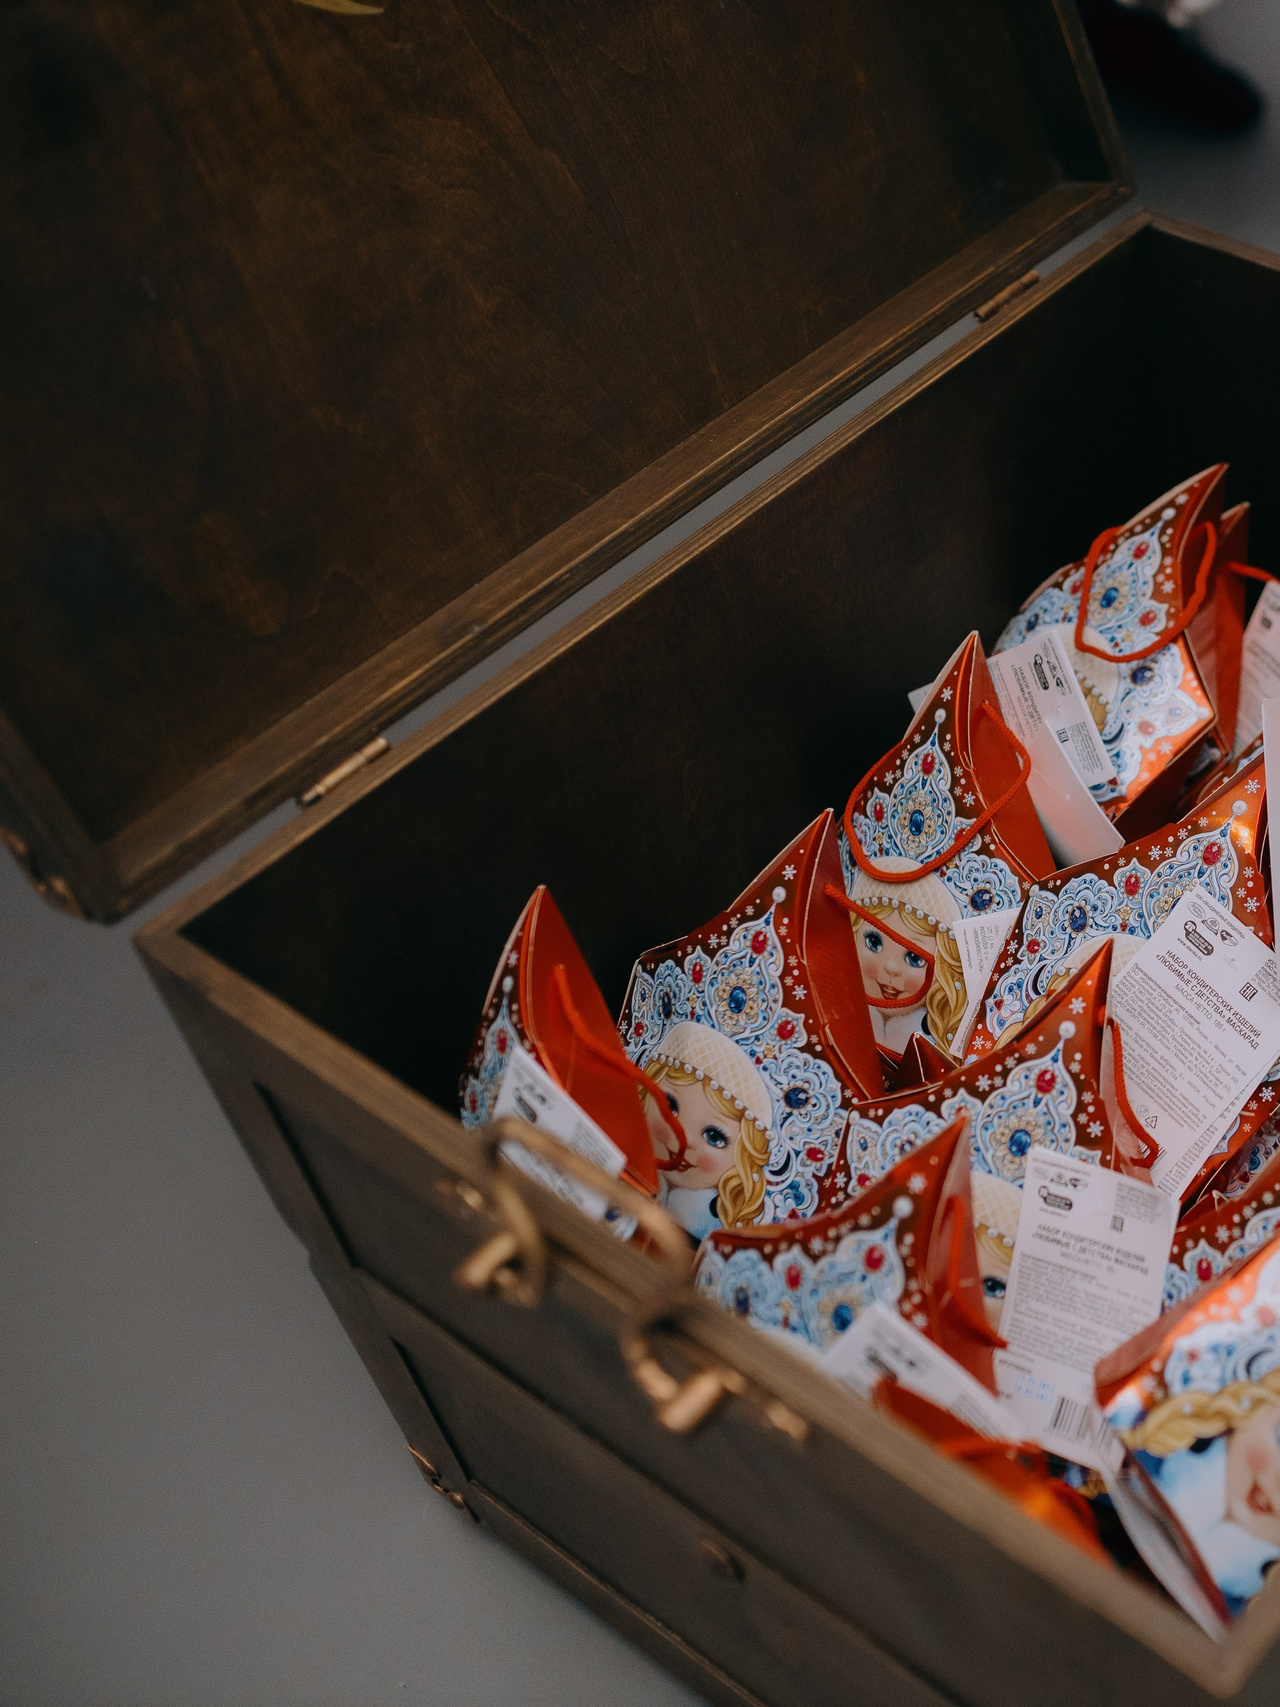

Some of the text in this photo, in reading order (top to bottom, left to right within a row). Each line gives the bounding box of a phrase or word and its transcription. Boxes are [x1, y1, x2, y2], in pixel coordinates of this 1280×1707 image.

[1154, 951, 1260, 1050] «ЛЮБИМЫЕ С ДЕТСТВА» МАСКАРАД
[1164, 949, 1262, 1039] НАБОР КОНДИТЕРСКИХ ИЗДЕЛИЙ
[1173, 983, 1195, 1004] МАССА
[1191, 1000, 1214, 1021] НЕТТО:
[1211, 1018, 1224, 1030] 185
[1239, 983, 1257, 1000] EAC
